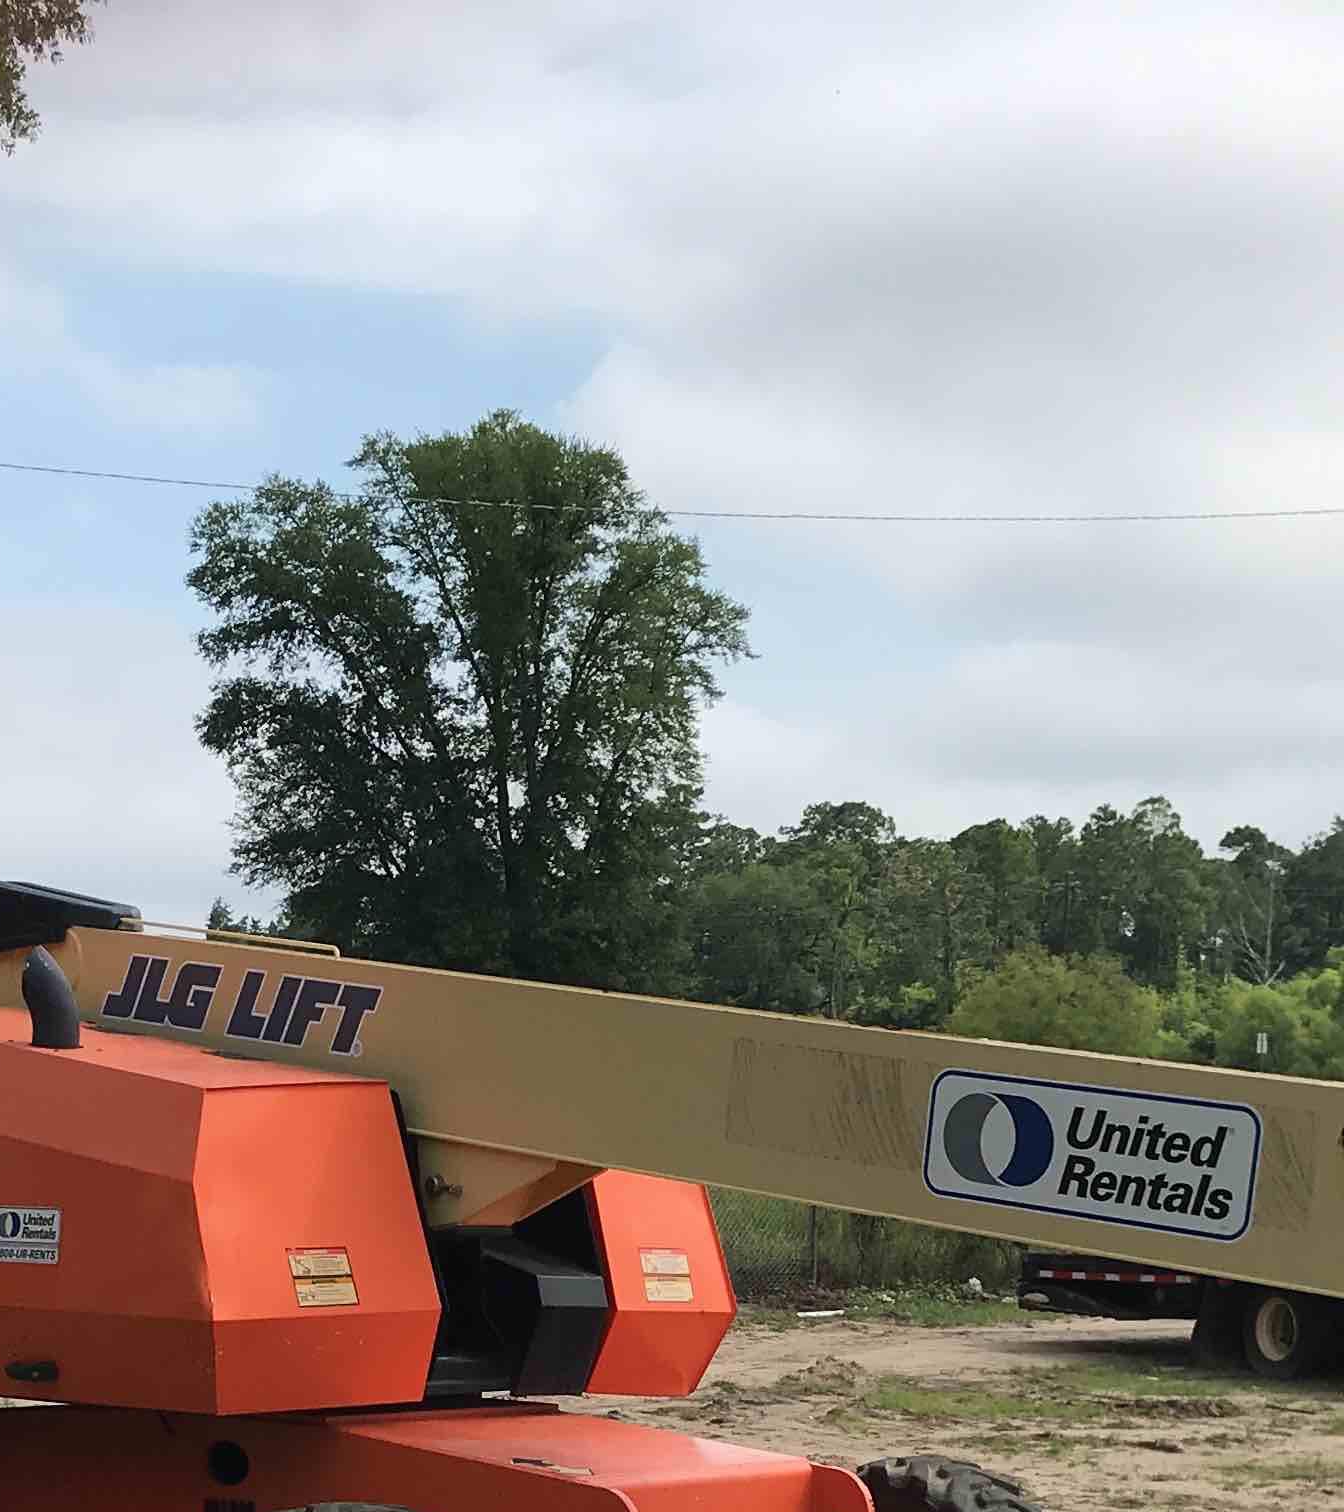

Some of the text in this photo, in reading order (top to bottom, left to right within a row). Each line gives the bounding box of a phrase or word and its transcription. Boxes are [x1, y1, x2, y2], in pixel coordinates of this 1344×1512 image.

[102, 953, 384, 1056] JLG LIFT
[1066, 1106, 1229, 1168] United
[1057, 1154, 1233, 1220] Rentals
[21, 1226, 57, 1240] Rentals
[23, 1212, 56, 1226] United
